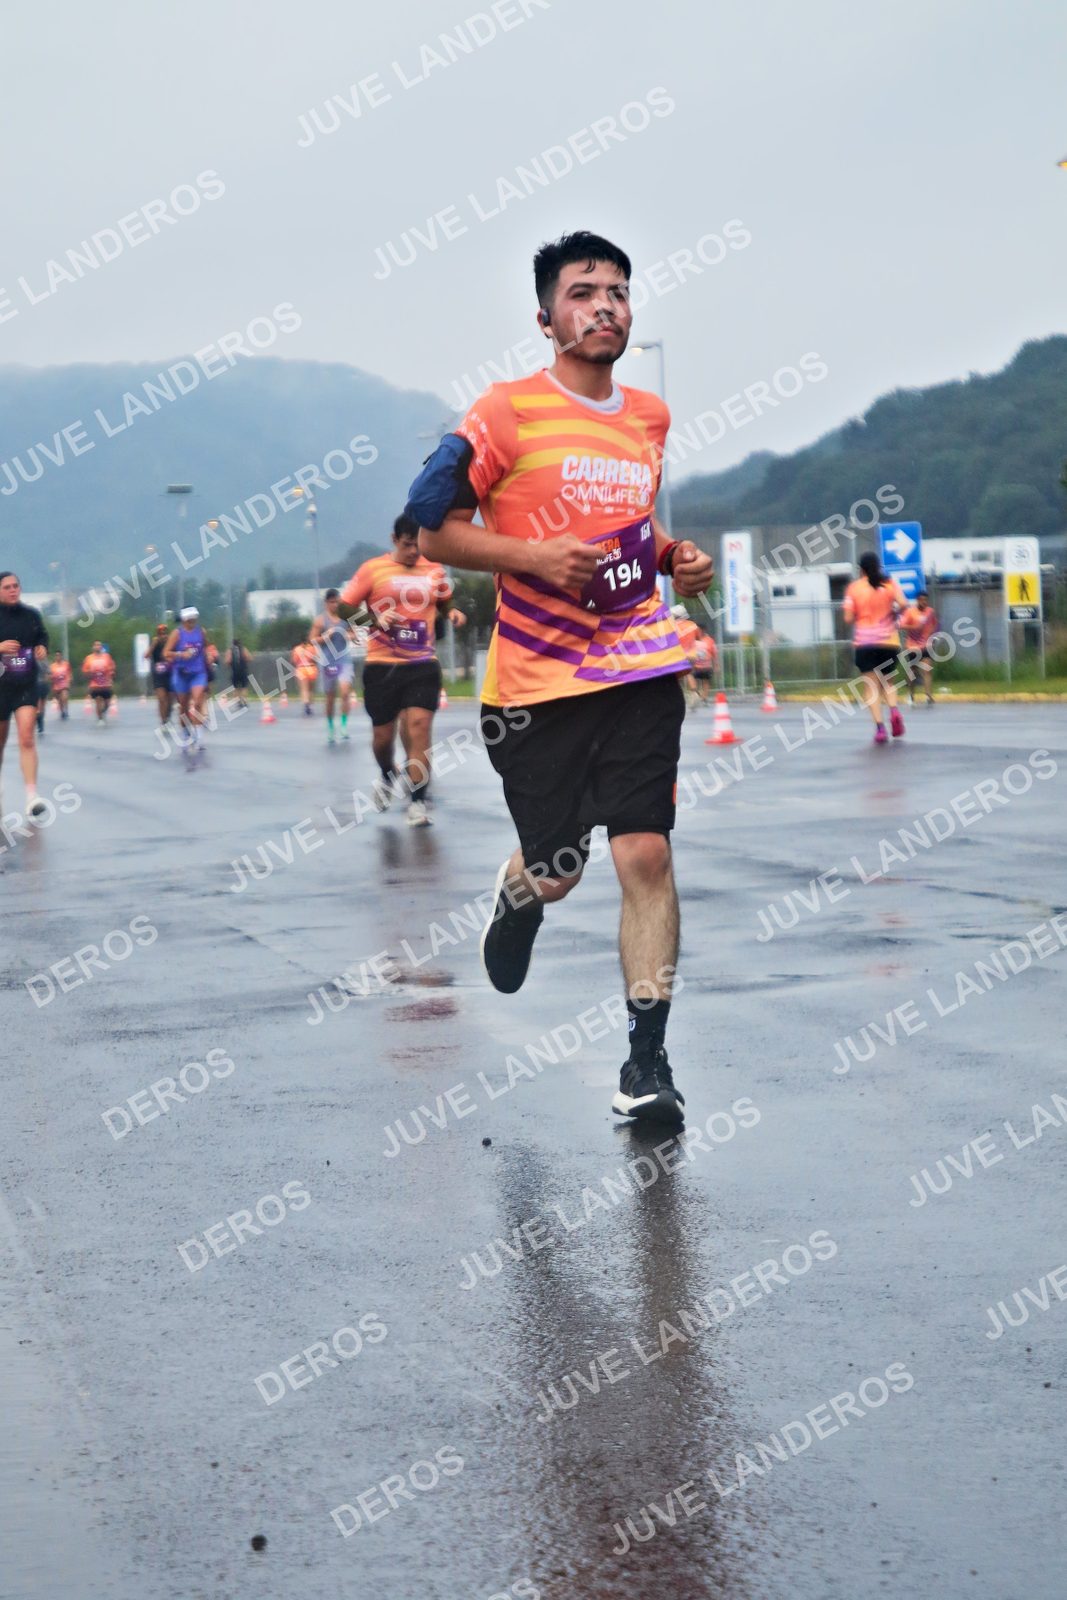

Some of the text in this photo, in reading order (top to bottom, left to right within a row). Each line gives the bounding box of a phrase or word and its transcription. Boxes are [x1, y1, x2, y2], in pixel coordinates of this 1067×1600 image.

[562, 454, 653, 487] CARRERA
[561, 483, 635, 504] OMNILIFE
[603, 558, 642, 592] 194
